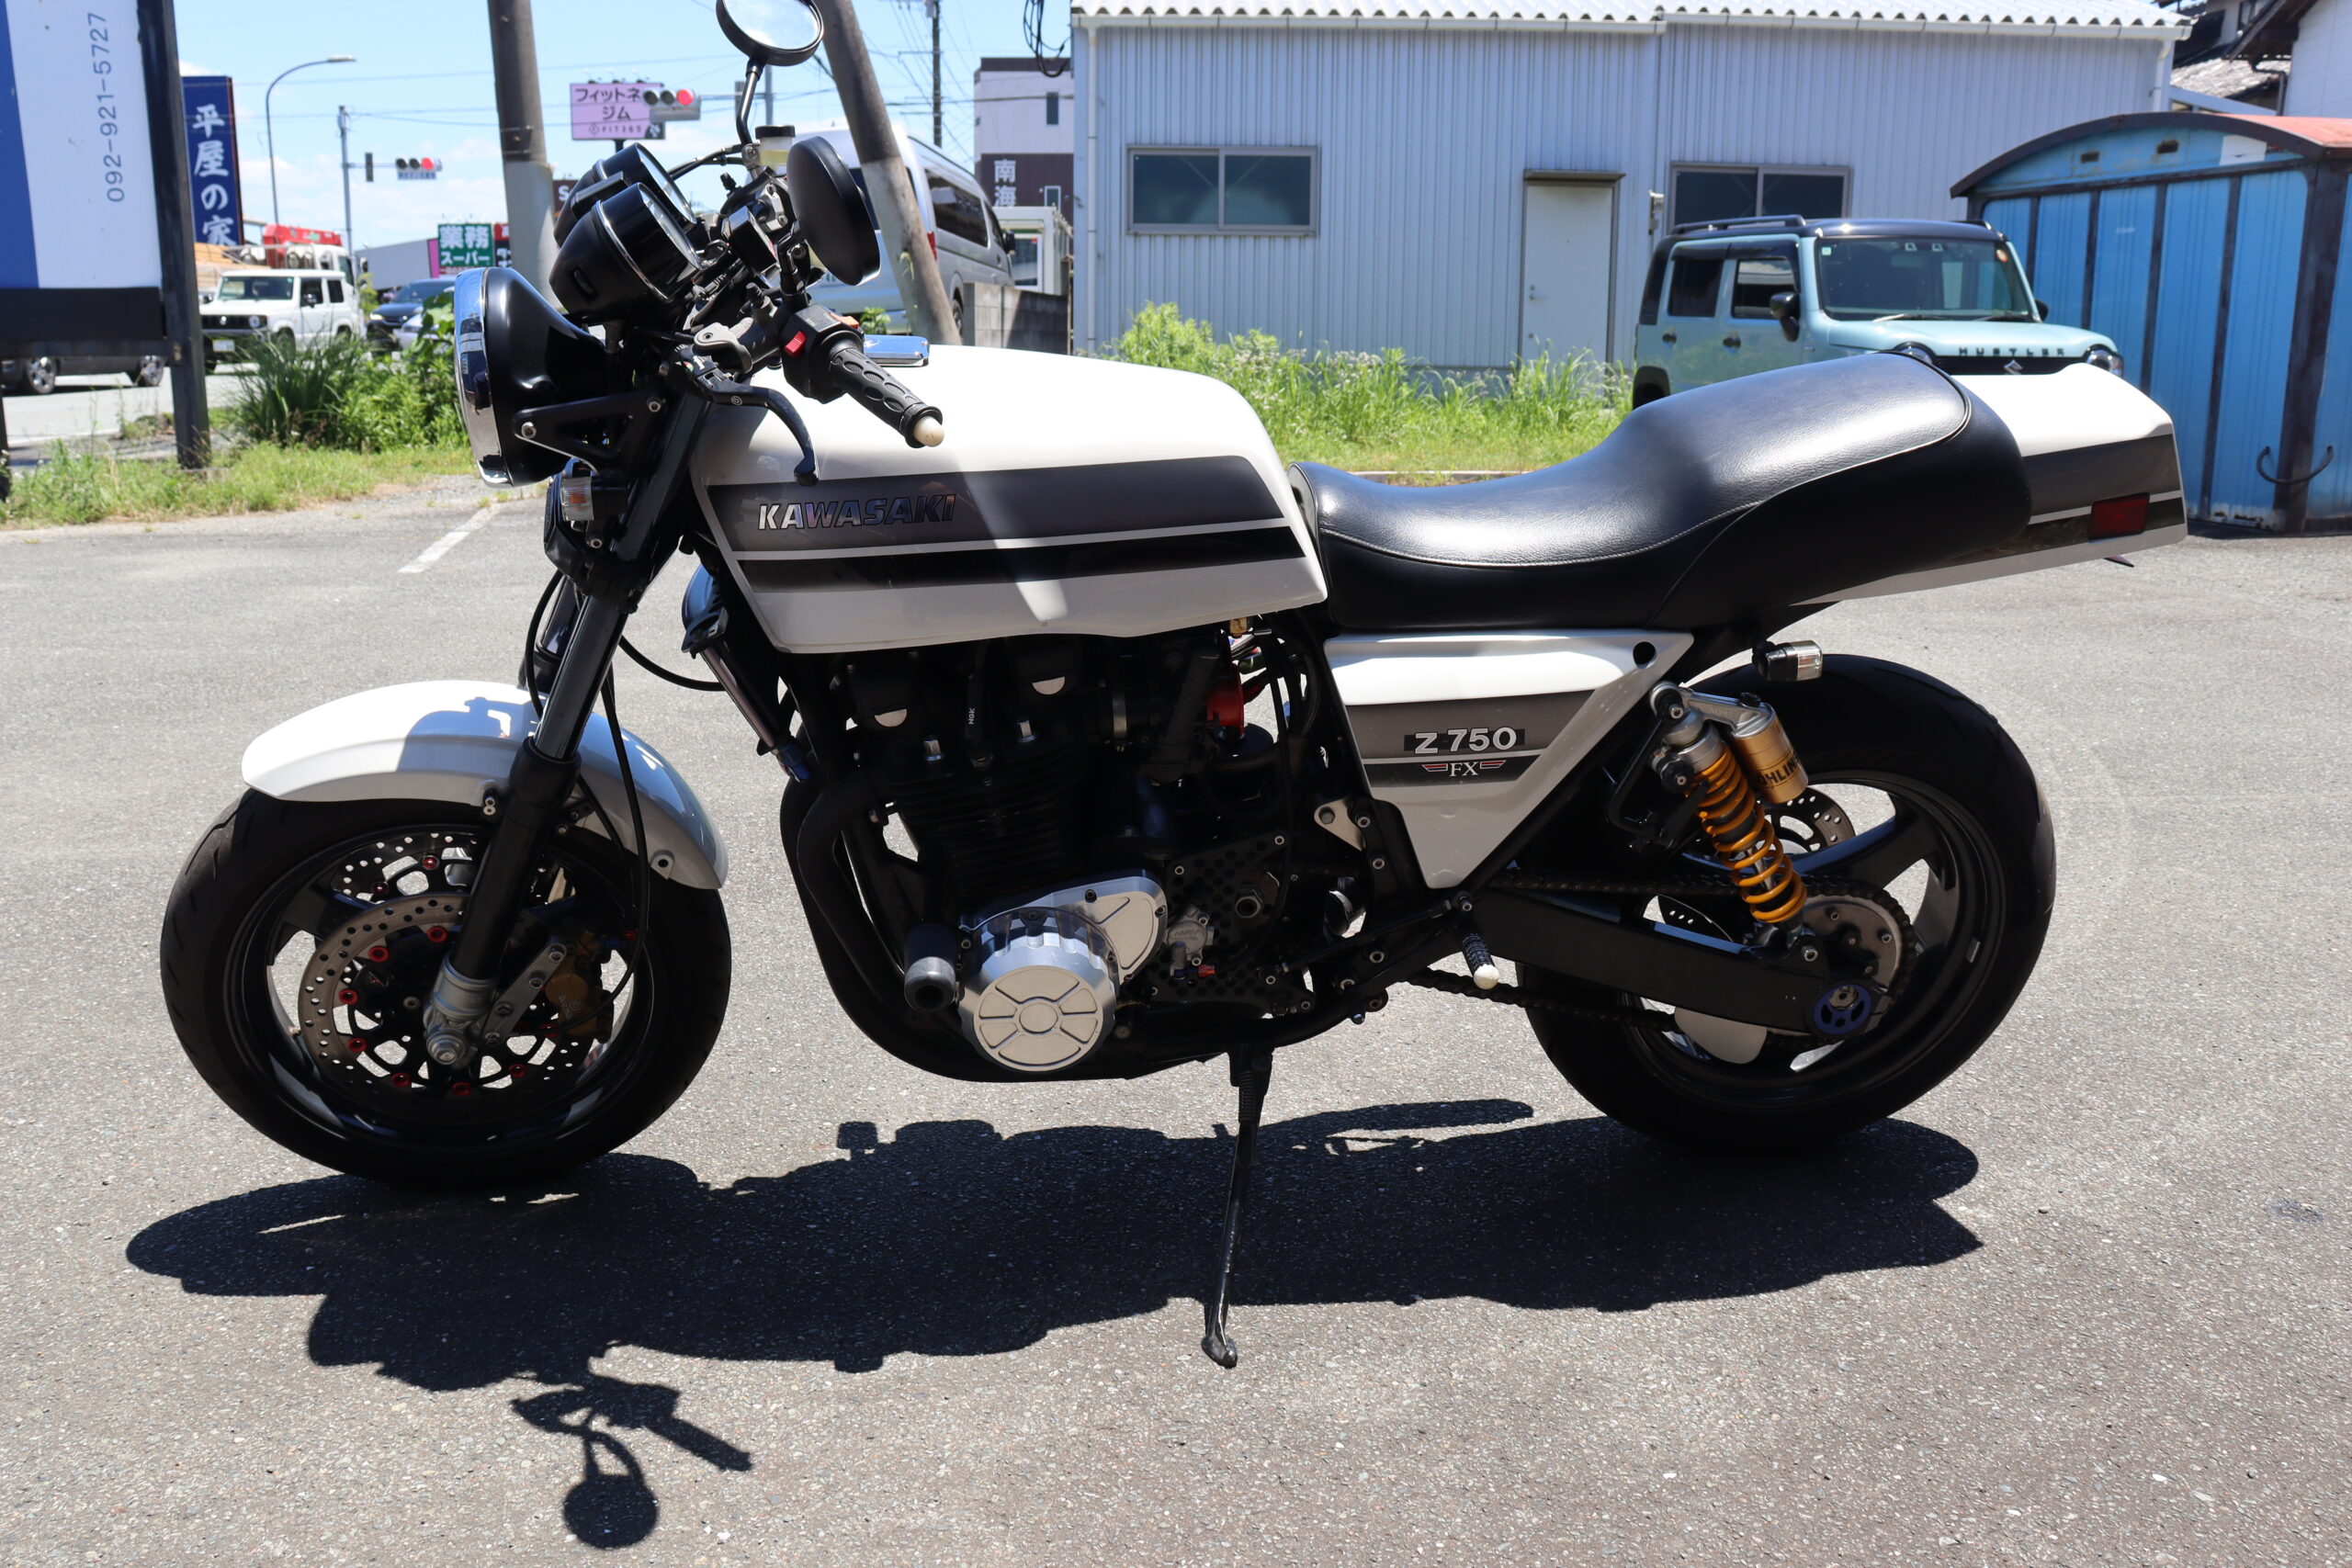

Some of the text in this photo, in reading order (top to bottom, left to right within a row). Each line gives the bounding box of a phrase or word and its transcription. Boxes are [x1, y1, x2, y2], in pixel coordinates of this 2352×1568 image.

[574, 87, 641, 103] フィットネ
[86, 12, 126, 203] 092-921-5727
[602, 106, 631, 121] ジム
[191, 103, 237, 247] 平屋の家
[439, 225, 490, 249] 業務
[440, 250, 491, 265] スーパー
[758, 493, 956, 531] KAWASAKI
[967, 707, 976, 725] NGK
[1415, 727, 1517, 754] Z 750
[1449, 761, 1480, 777] FX
